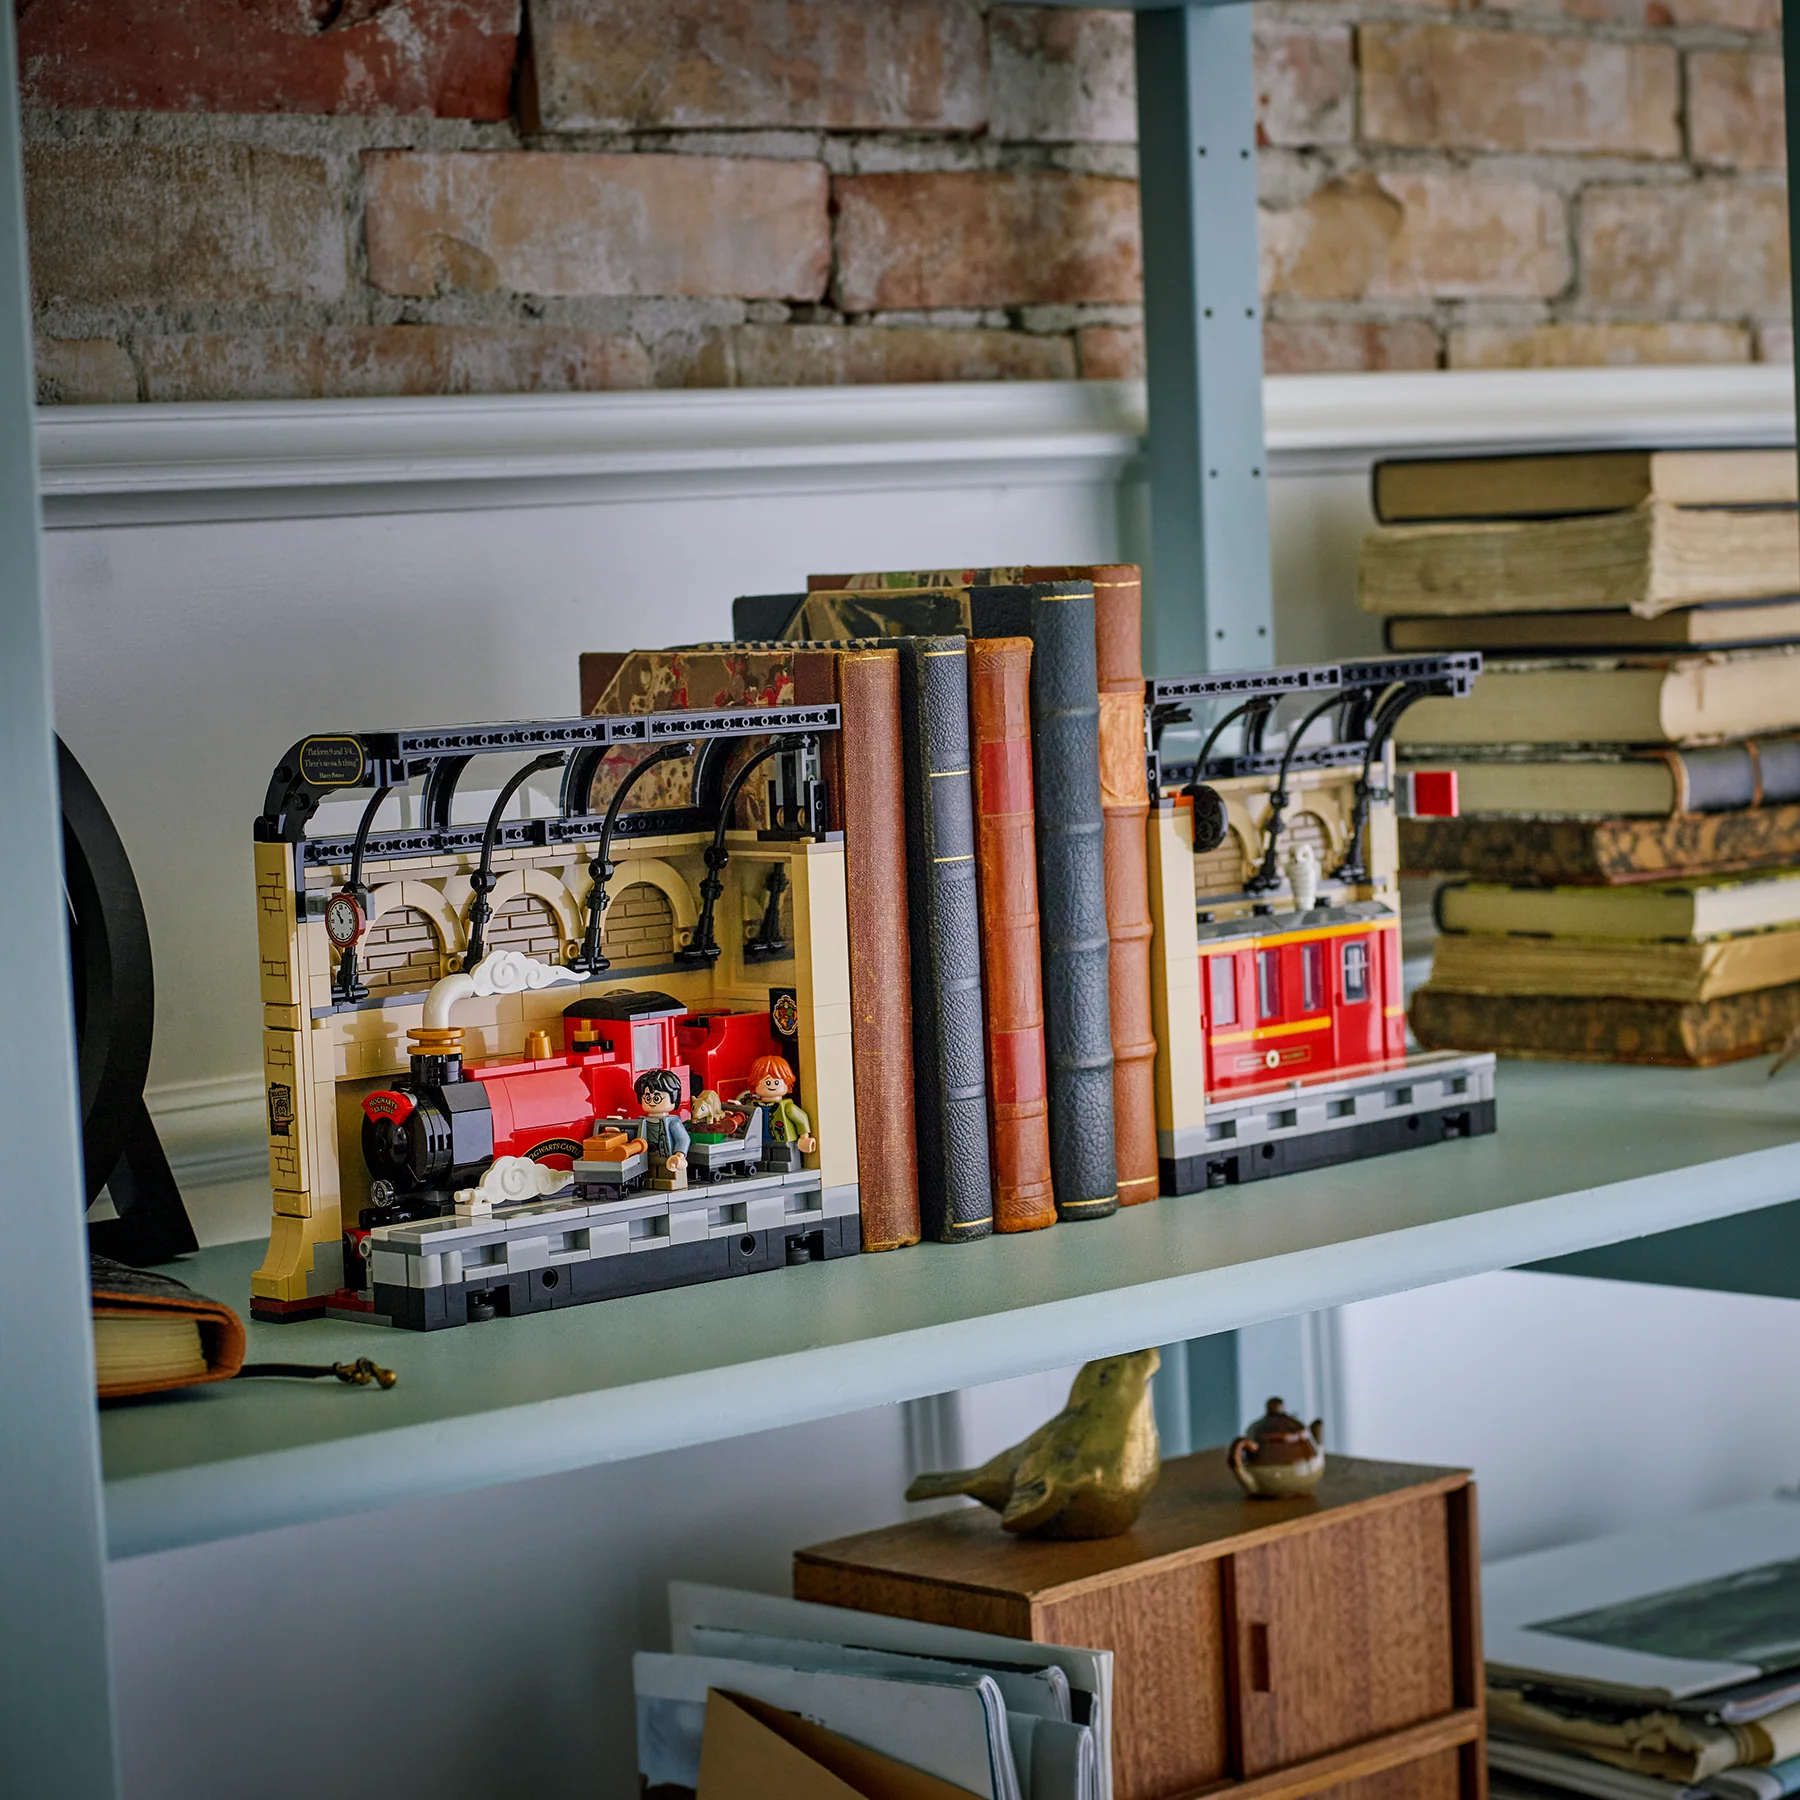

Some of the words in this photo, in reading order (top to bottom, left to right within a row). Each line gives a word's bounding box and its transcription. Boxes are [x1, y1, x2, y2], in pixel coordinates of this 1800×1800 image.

[369, 1097, 398, 1110] HOGWARTS
[528, 1143, 561, 1160] OGWARTS
[560, 1142, 583, 1156] CASTLE
